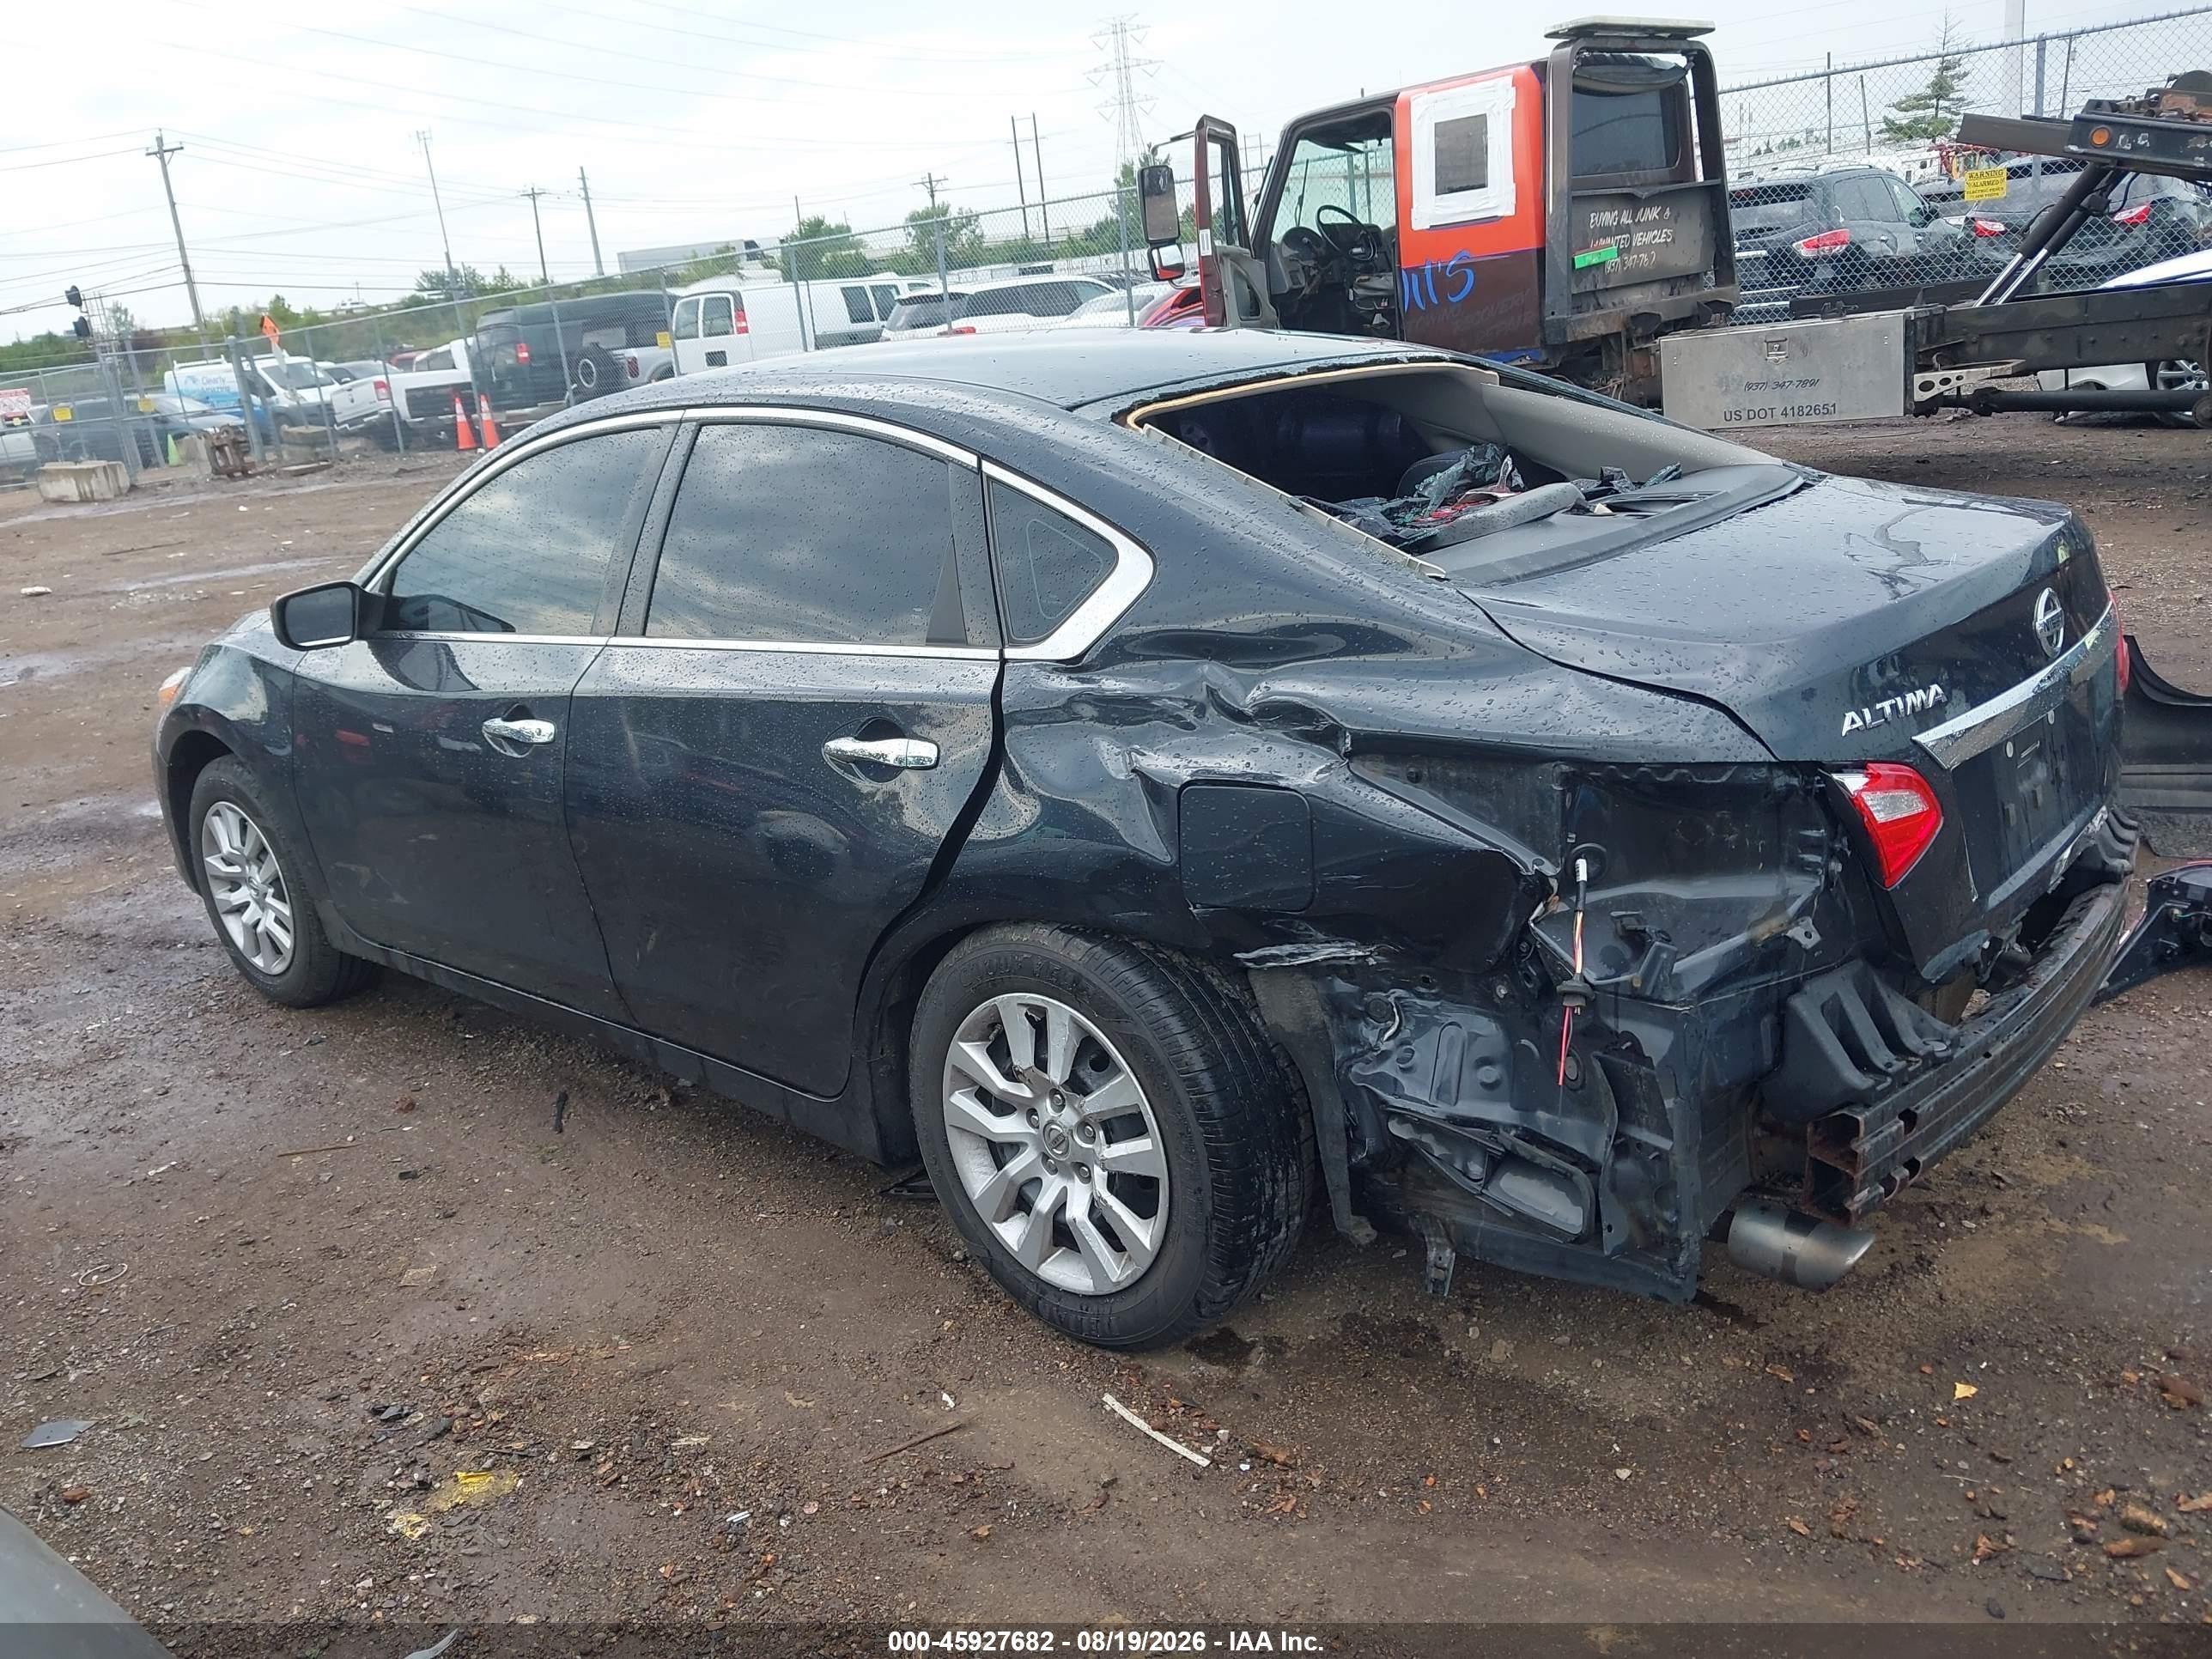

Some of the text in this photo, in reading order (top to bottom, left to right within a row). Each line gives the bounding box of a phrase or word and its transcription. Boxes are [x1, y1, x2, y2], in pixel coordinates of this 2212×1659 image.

[1968, 169, 2003, 179] WARNING
[1972, 179, 2000, 188] ALARMED
[1589, 206, 1671, 229] BUYING ALL JUNK &
[1632, 229, 1674, 247] VEHICLES
[1744, 378, 1820, 392] (937) 347-7891
[1723, 403, 1837, 422] US DOT 4182651
[1841, 684, 1948, 737] ALTIMA
